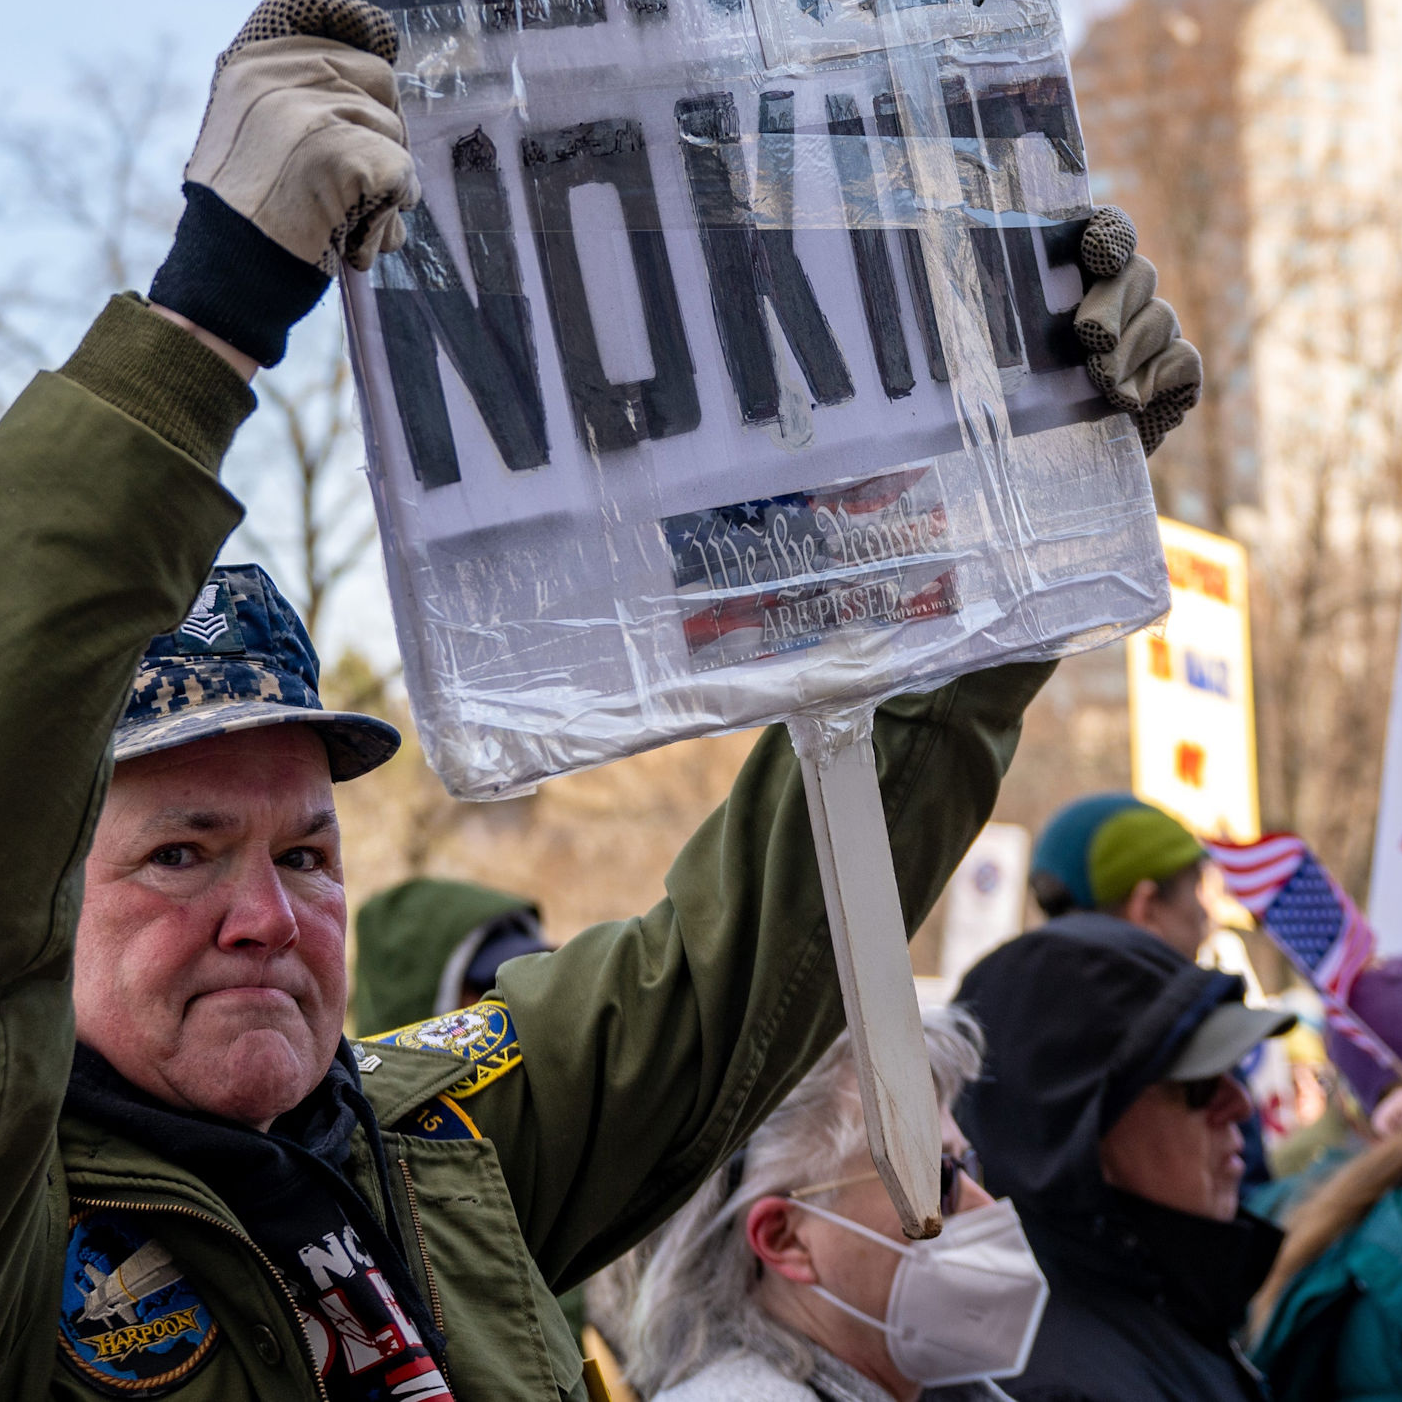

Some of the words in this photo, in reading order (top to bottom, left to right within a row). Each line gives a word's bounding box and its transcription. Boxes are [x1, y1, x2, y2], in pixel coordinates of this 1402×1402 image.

[373, 119, 701, 490] NO
[689, 516, 759, 618] We
[746, 512, 820, 599] the
[812, 491, 942, 588] People
[762, 605, 815, 642] ARE
[818, 581, 900, 629] PISSED
[416, 1109, 443, 1132] 15
[98, 1309, 198, 1355] HARPOON
